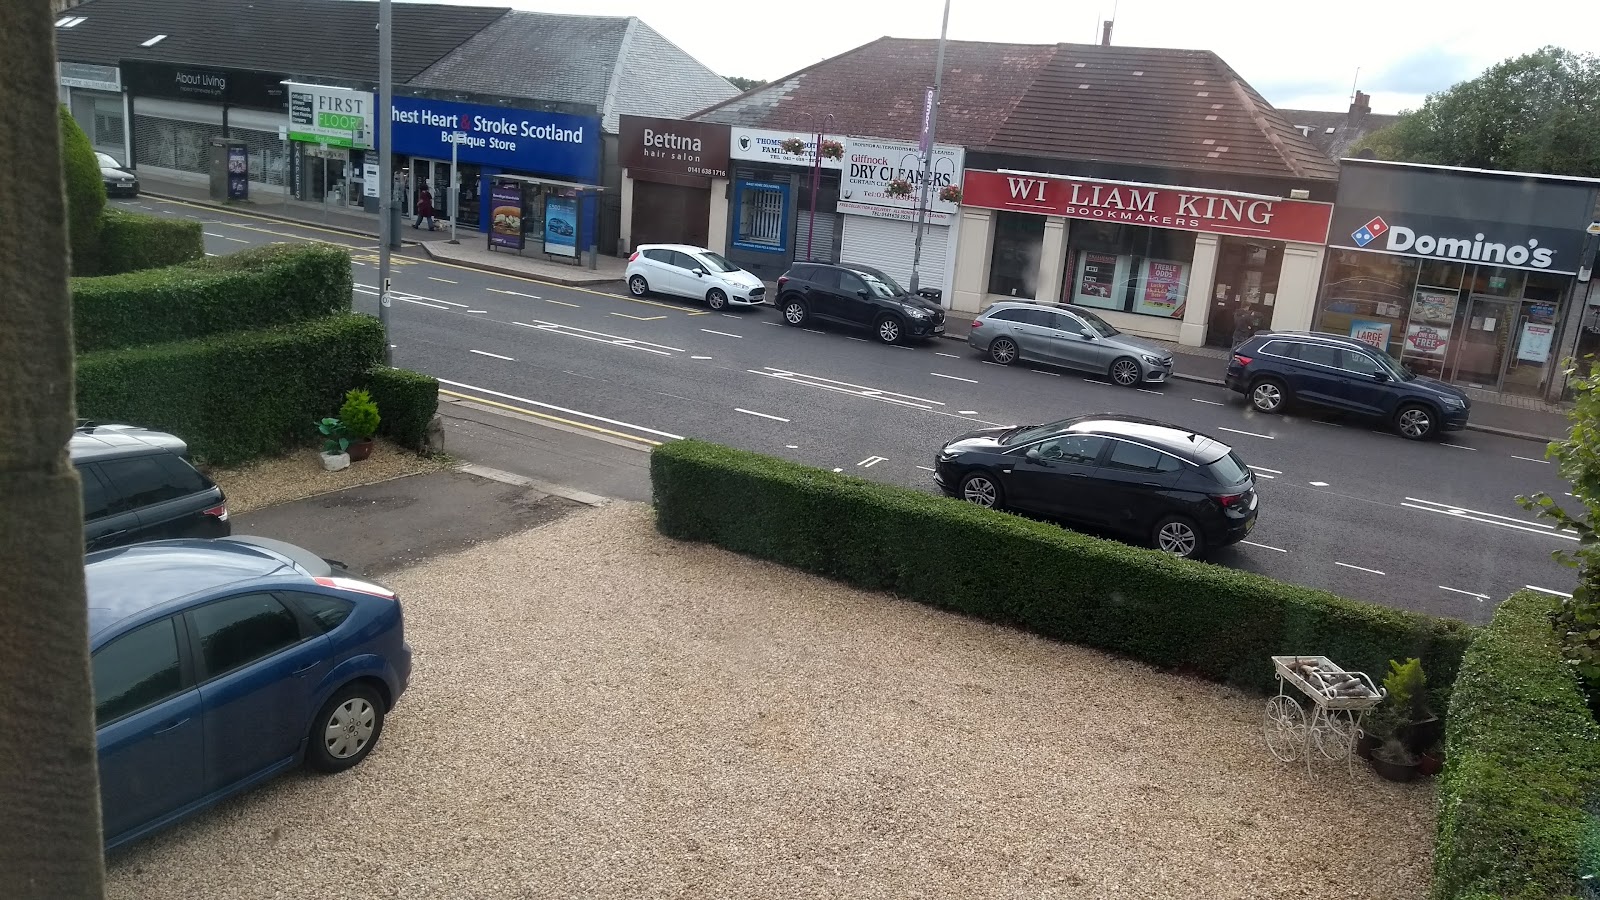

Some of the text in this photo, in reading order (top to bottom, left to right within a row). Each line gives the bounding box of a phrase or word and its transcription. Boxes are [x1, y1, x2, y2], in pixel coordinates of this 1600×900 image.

[176, 72, 226, 90] About Living
[319, 96, 363, 114] FIRST
[391, 106, 583, 144] hest Heart & Stroke Scotland
[441, 131, 486, 148] Boique
[489, 136, 516, 151] Store
[643, 128, 702, 152] Bettina
[644, 148, 700, 162] hair salon
[851, 154, 888, 166] Giffnock
[701, 167, 712, 176] 638
[712, 169, 726, 177] 1716
[850, 163, 877, 180] DRY
[1066, 206, 1199, 228] BOOKMAKERS
[1175, 194, 1274, 225] KING
[1386, 225, 1553, 268] Domino's
[1154, 263, 1177, 272] TREBLE
[1356, 330, 1383, 342] LARGE
[1416, 337, 1436, 348] FREE
